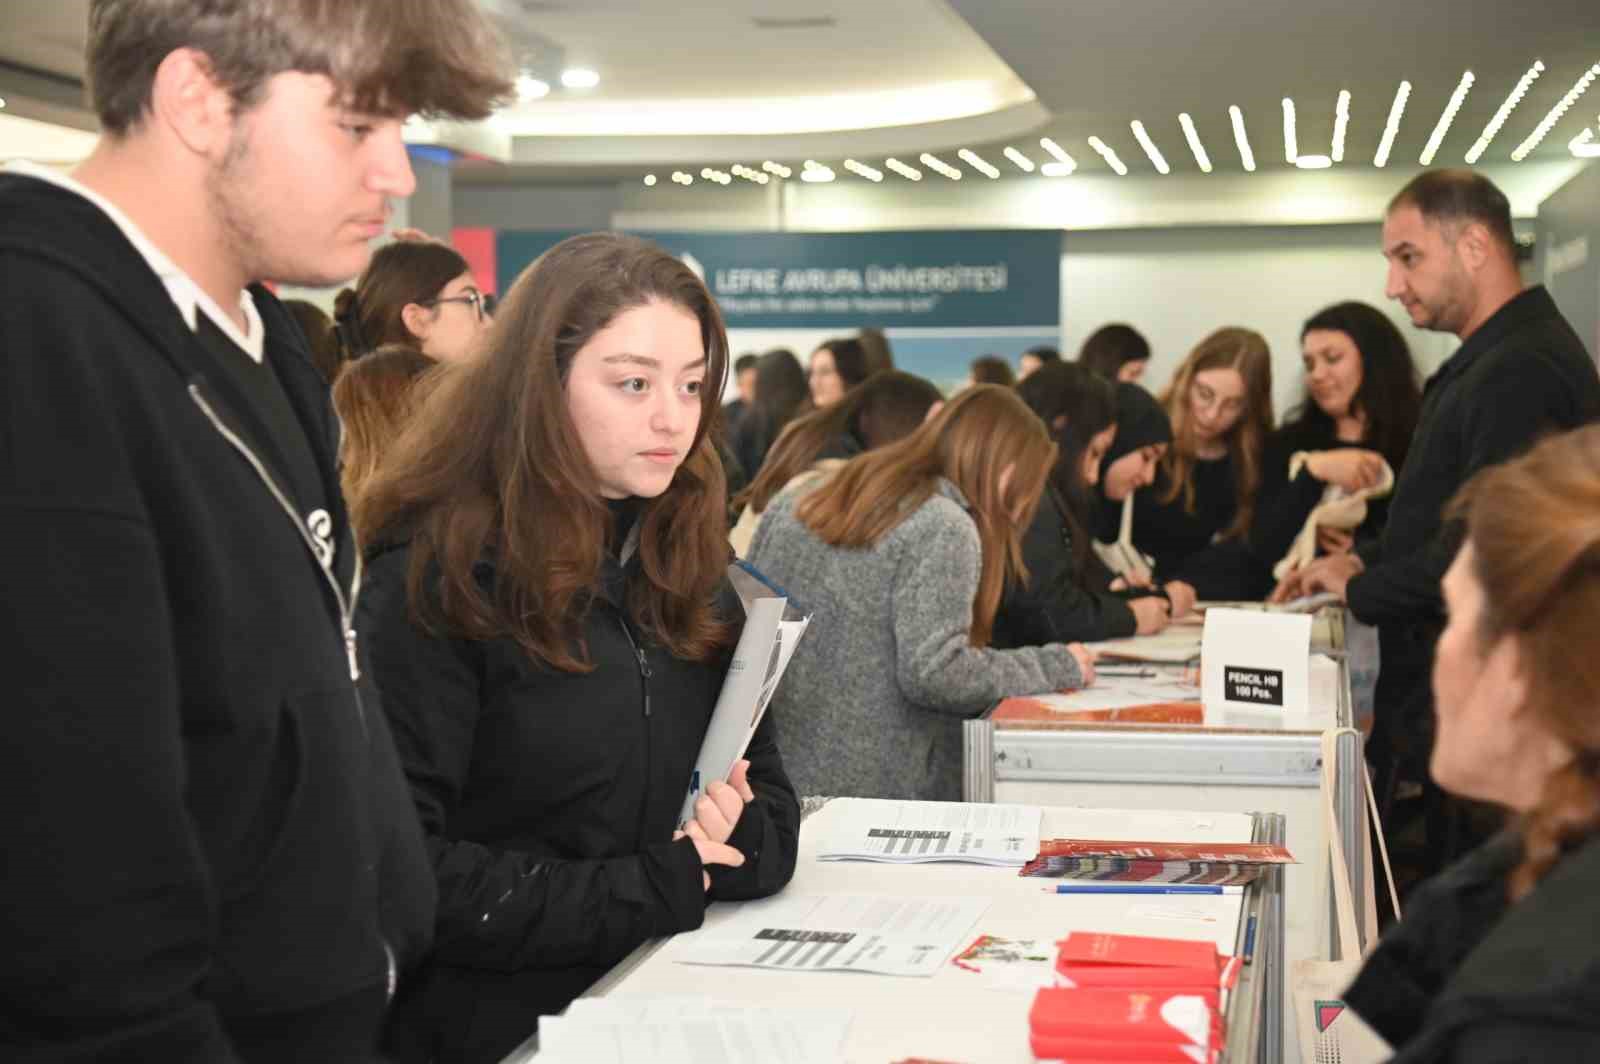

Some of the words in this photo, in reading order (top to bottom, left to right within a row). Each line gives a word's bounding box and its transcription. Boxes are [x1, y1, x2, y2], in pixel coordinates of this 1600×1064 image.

[782, 268, 863, 292] AVRUPA
[1228, 671, 1262, 686] PENCIL
[1263, 674, 1279, 688] HB
